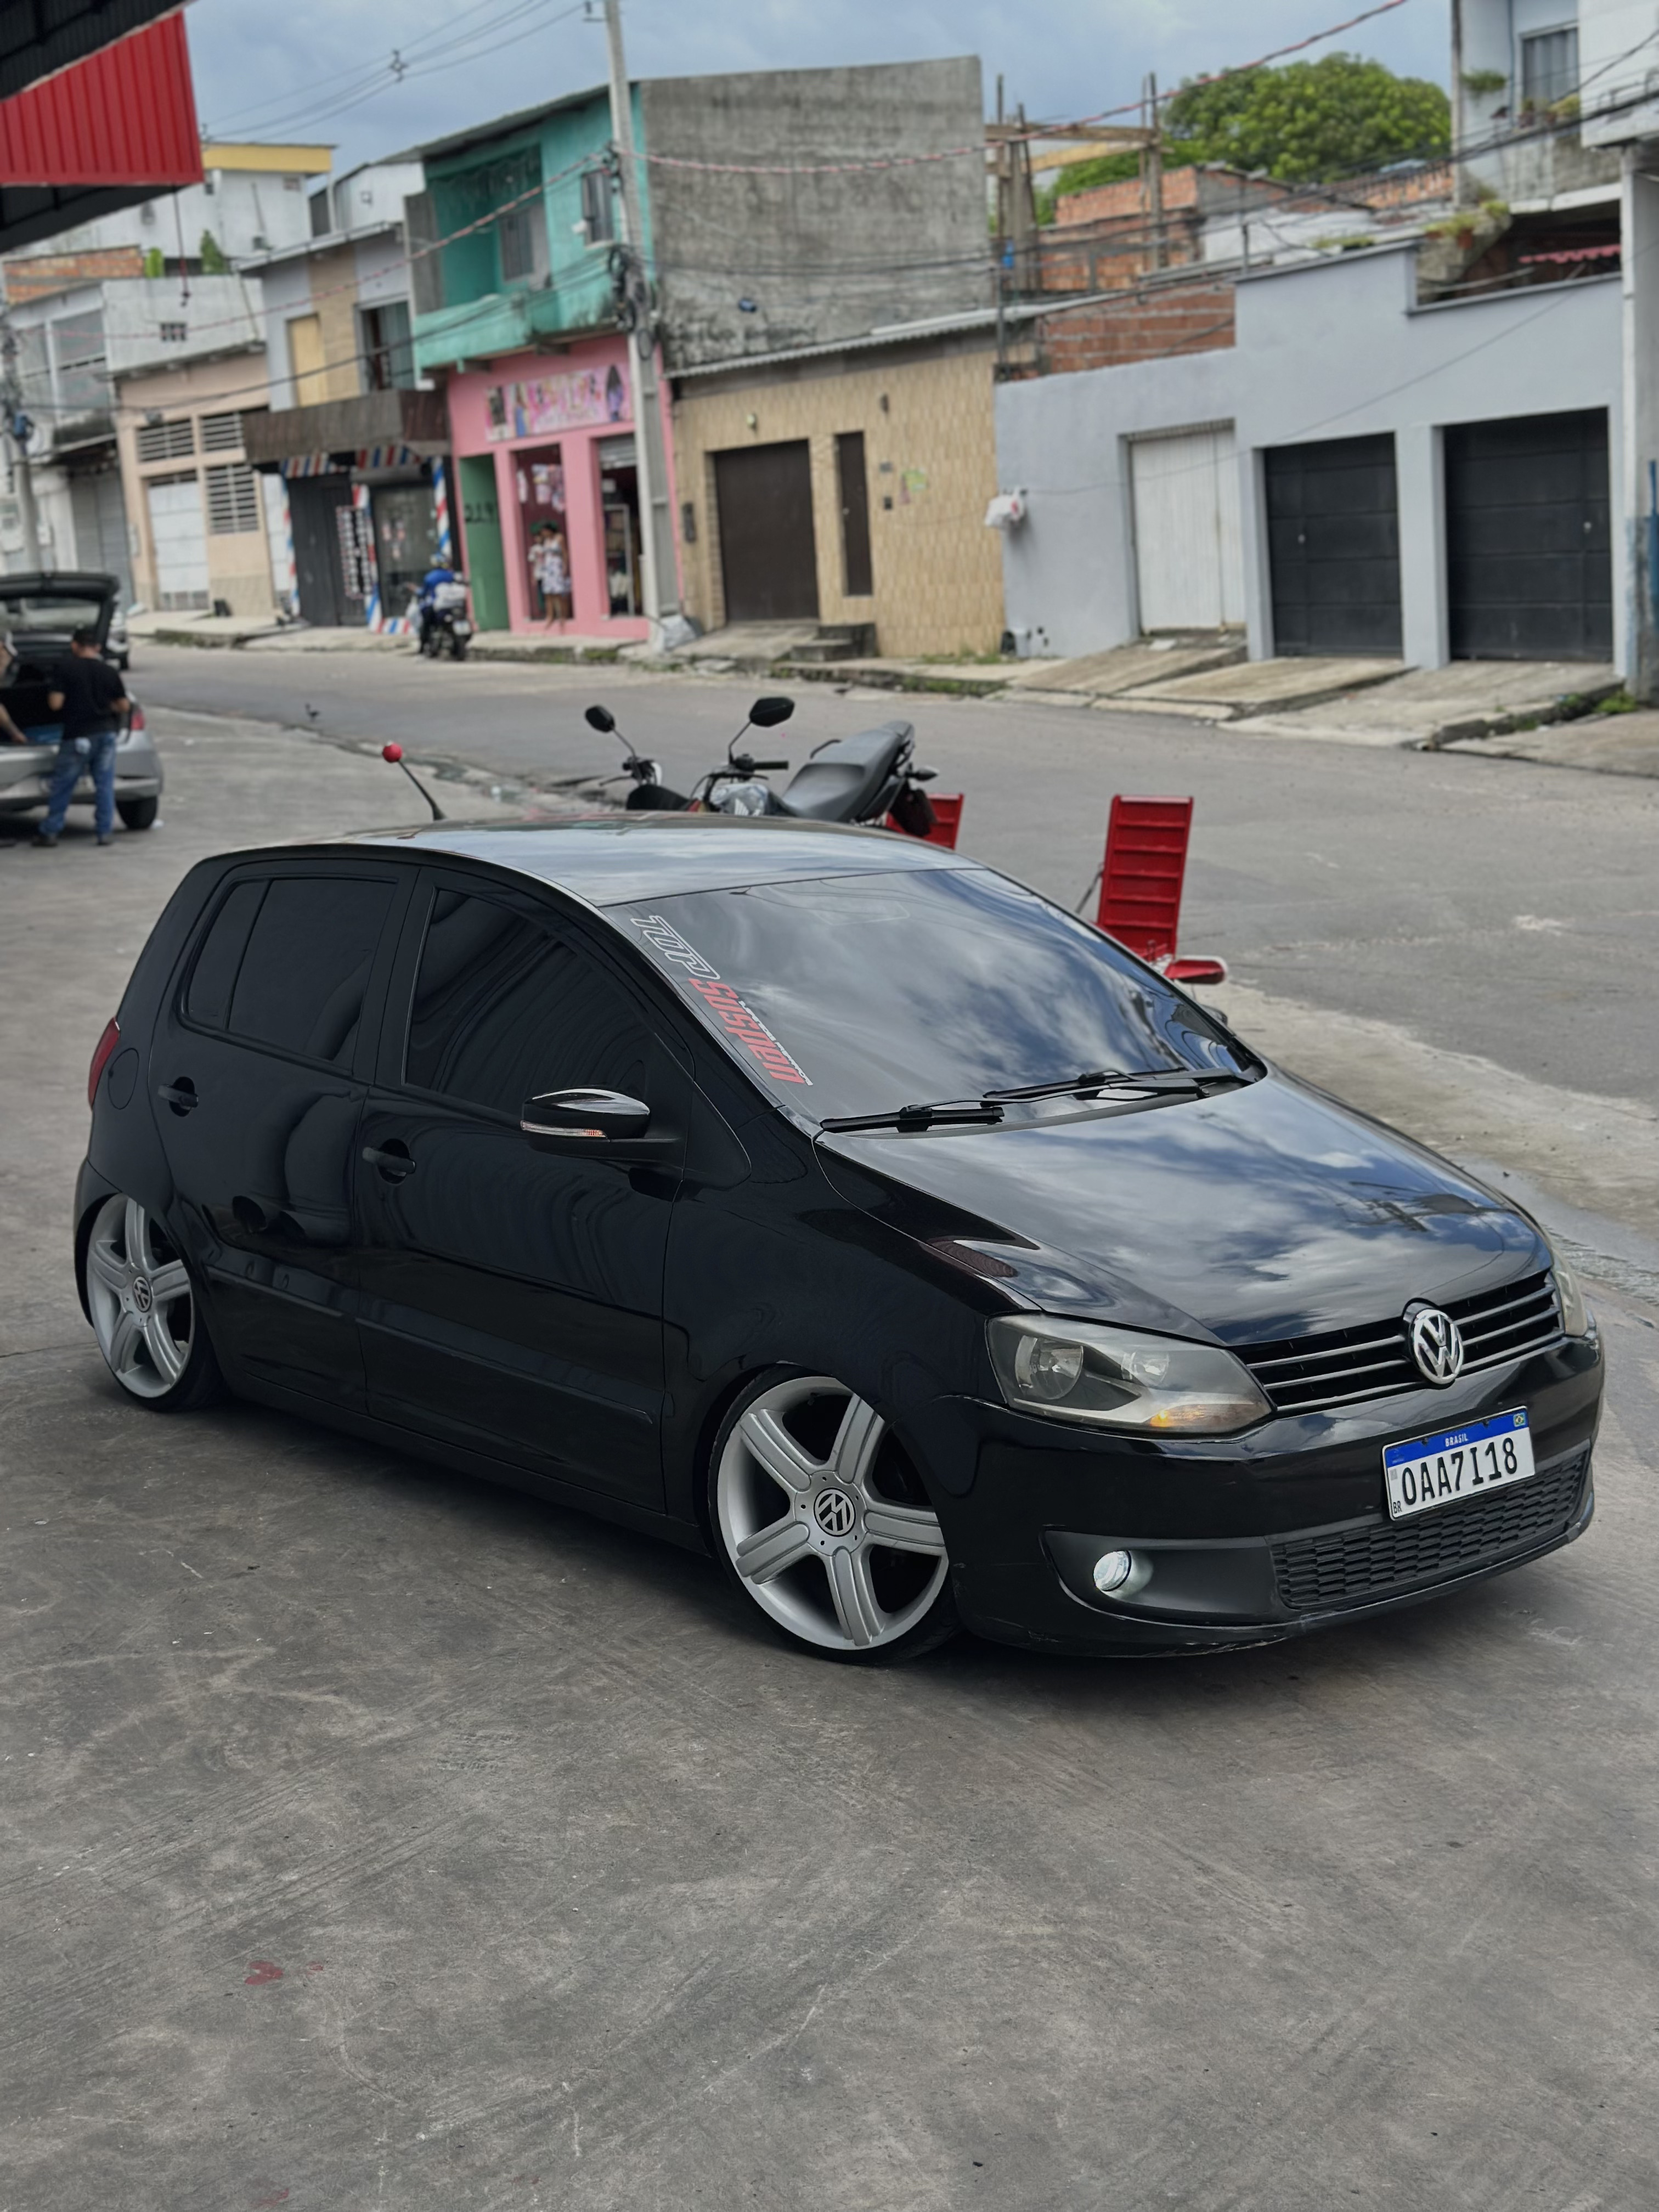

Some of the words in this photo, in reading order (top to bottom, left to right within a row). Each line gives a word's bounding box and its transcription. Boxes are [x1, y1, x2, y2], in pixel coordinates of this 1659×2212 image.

[630, 915, 720, 980] TOP
[1444, 1433, 1468, 1447] BRASIL
[1393, 1500, 1402, 1514] BR
